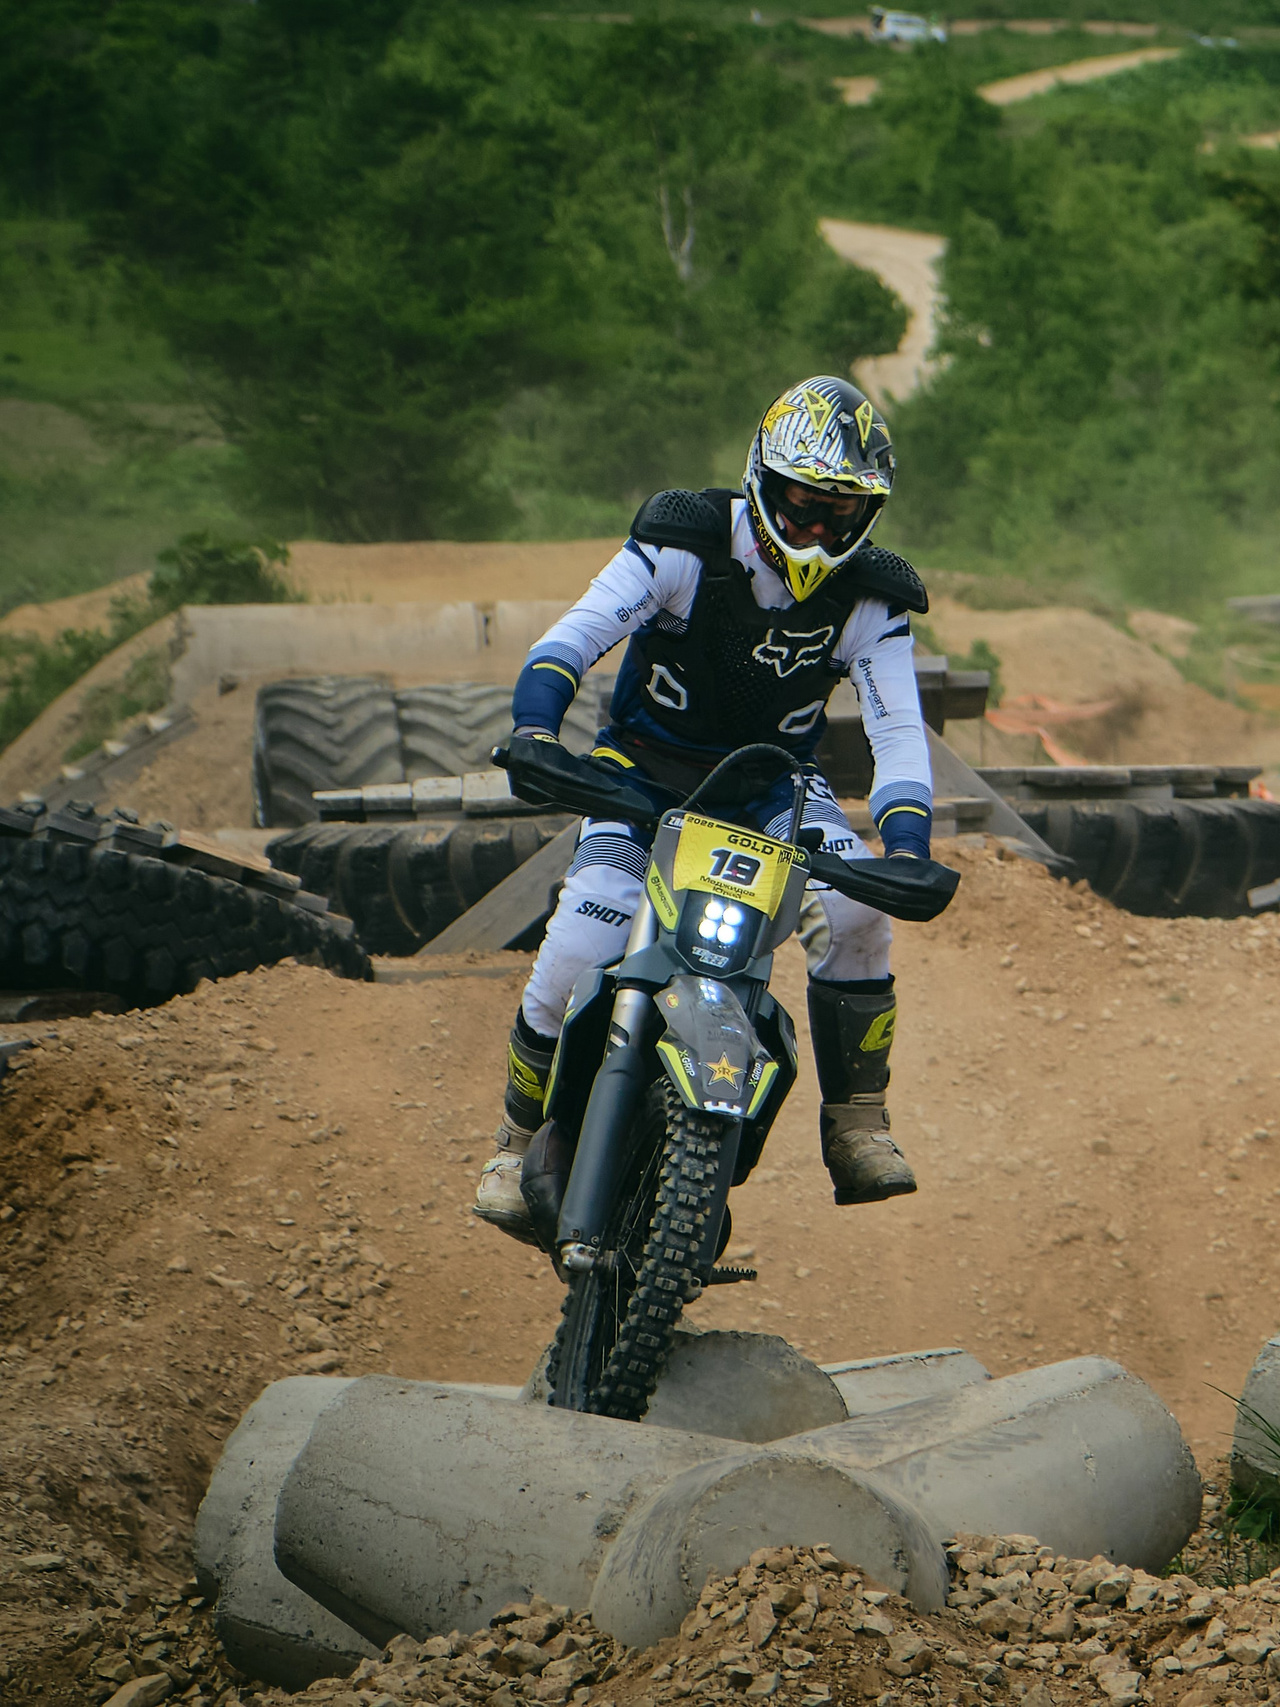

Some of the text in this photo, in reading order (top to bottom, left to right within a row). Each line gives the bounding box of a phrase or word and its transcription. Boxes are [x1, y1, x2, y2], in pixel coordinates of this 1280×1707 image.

[727, 833, 775, 856] GOLD
[819, 838, 854, 853] HOT
[708, 847, 763, 887] 19
[574, 900, 632, 927] SHOT
